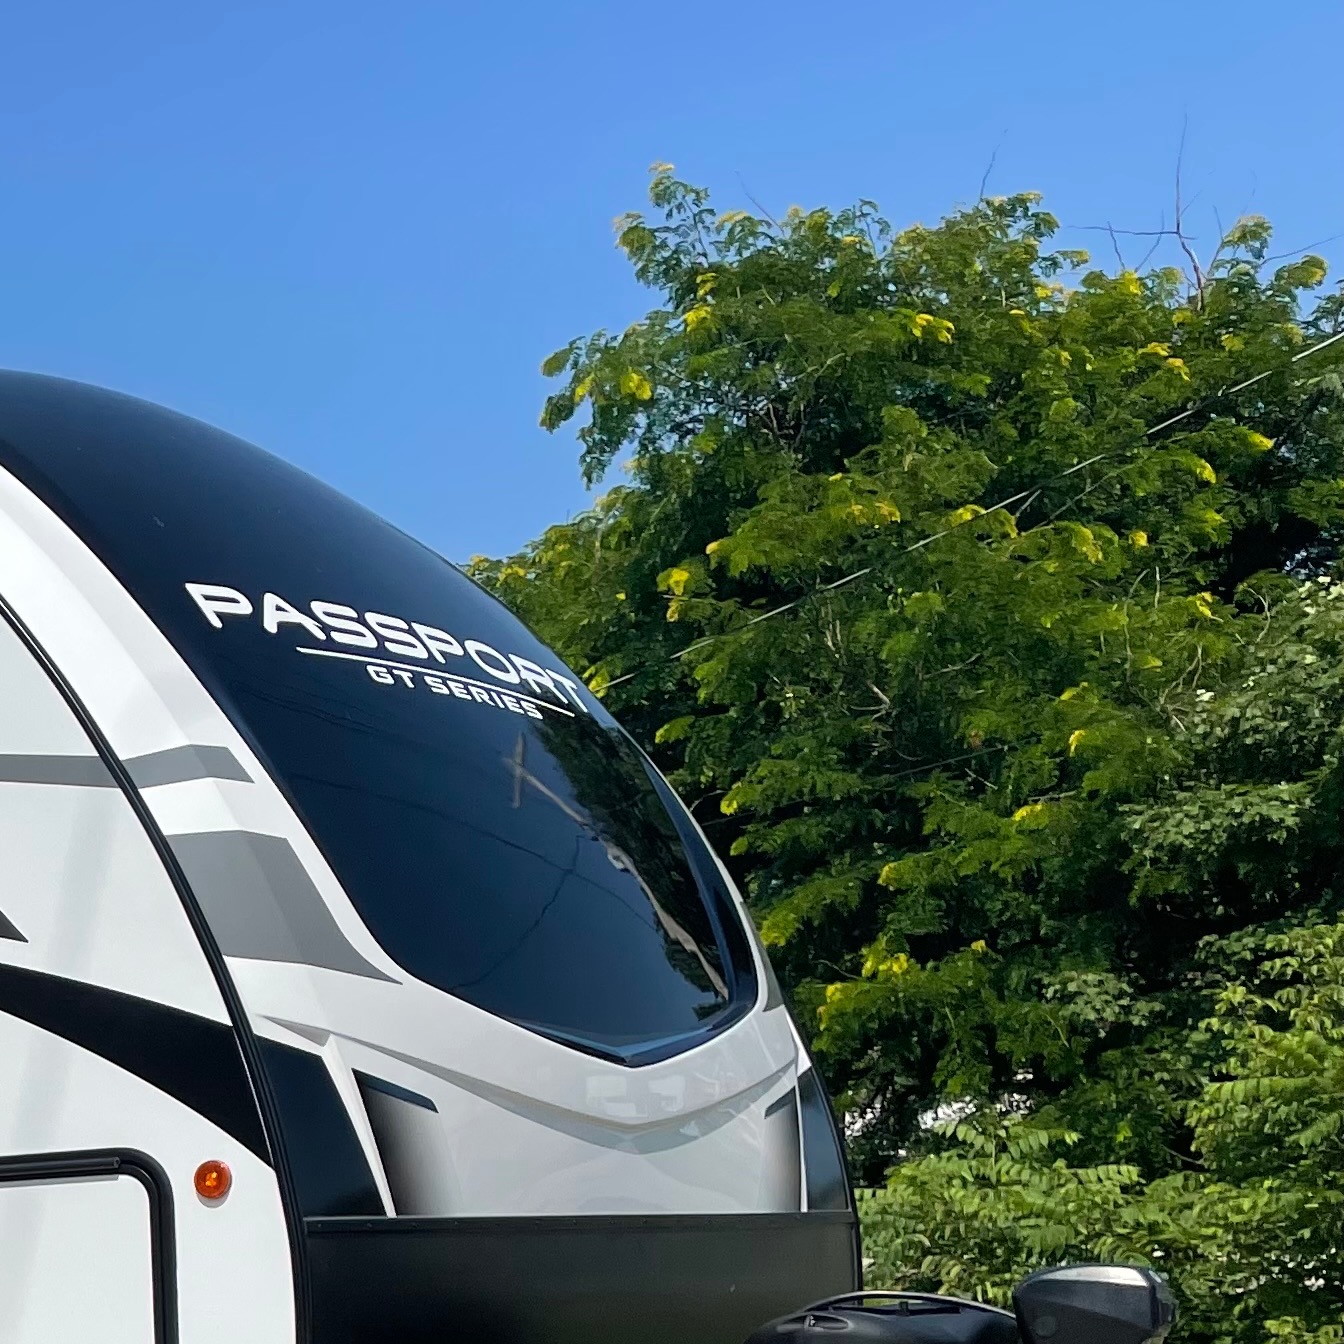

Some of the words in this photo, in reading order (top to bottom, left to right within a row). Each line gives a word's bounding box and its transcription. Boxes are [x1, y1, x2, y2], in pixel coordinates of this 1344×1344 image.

[185, 582, 589, 713] PASSPORT
[366, 664, 416, 690] GT
[423, 674, 544, 720] SERIES
